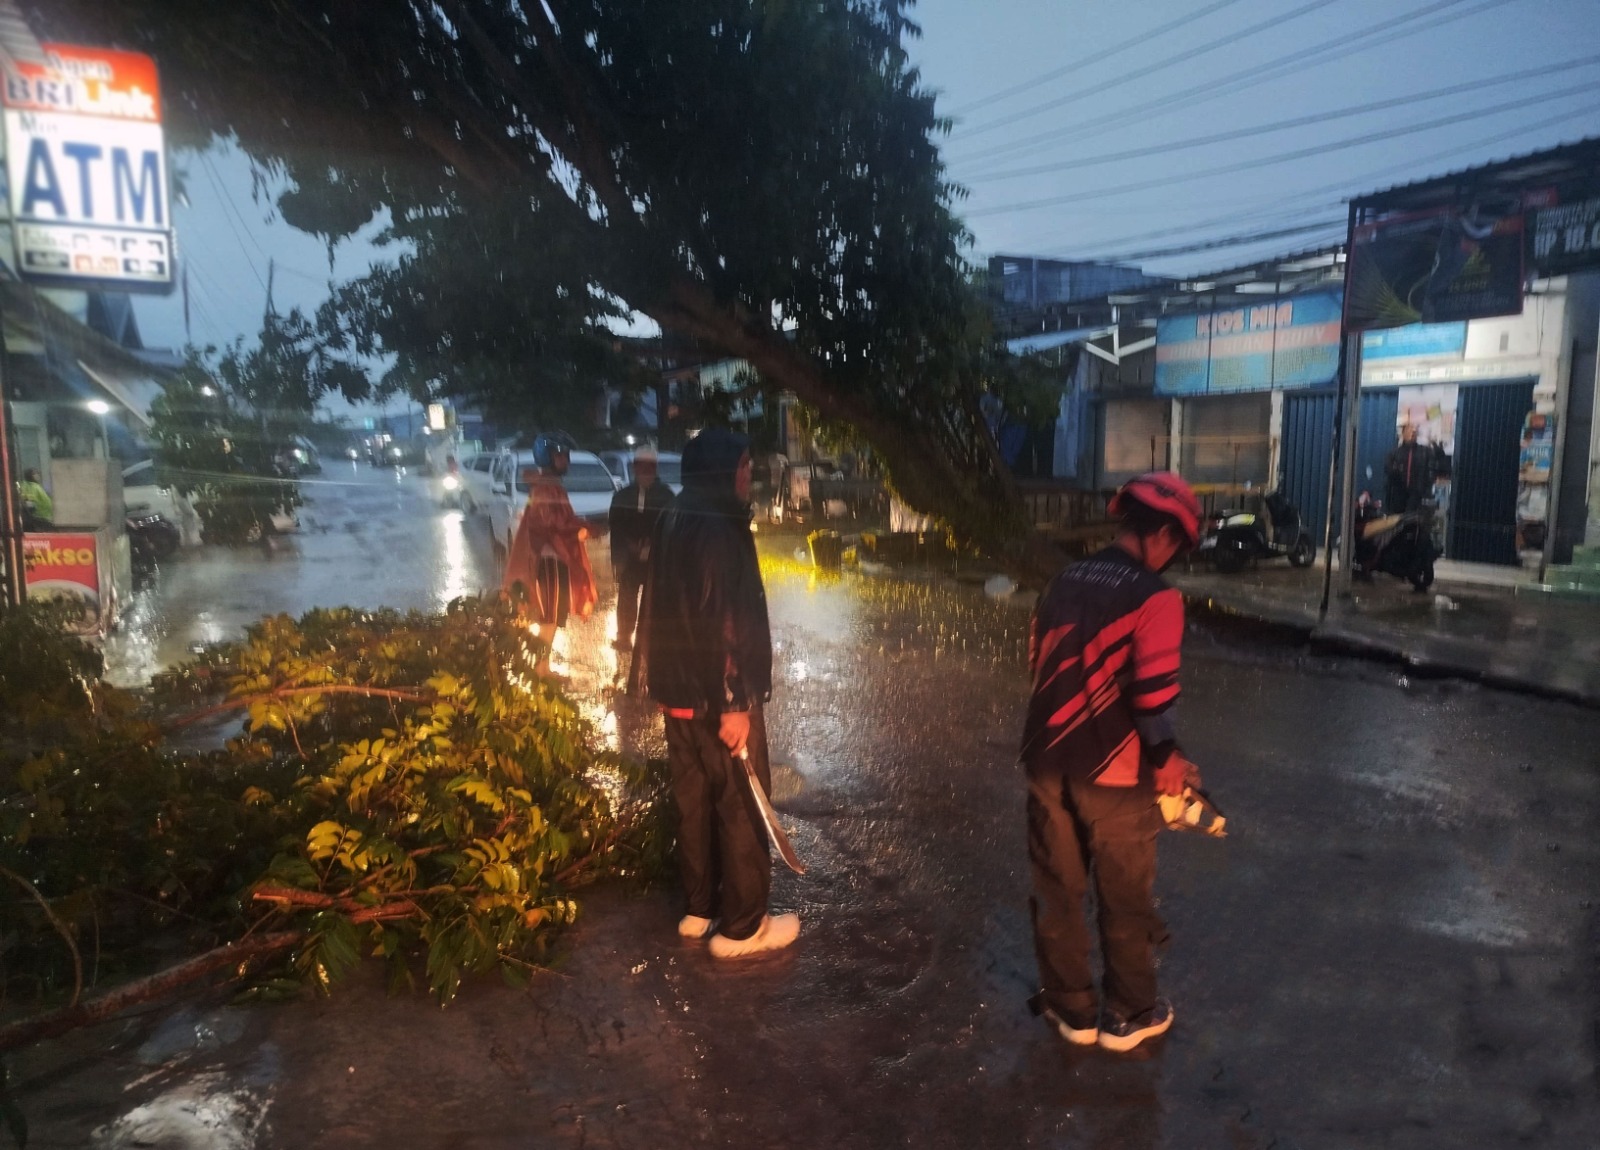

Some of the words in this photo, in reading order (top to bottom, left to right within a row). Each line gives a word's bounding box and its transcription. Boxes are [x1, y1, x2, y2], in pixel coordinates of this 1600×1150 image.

[22, 137, 163, 225] ATM
[1197, 308, 1245, 337] KIOS
[1250, 301, 1293, 328] MIA
